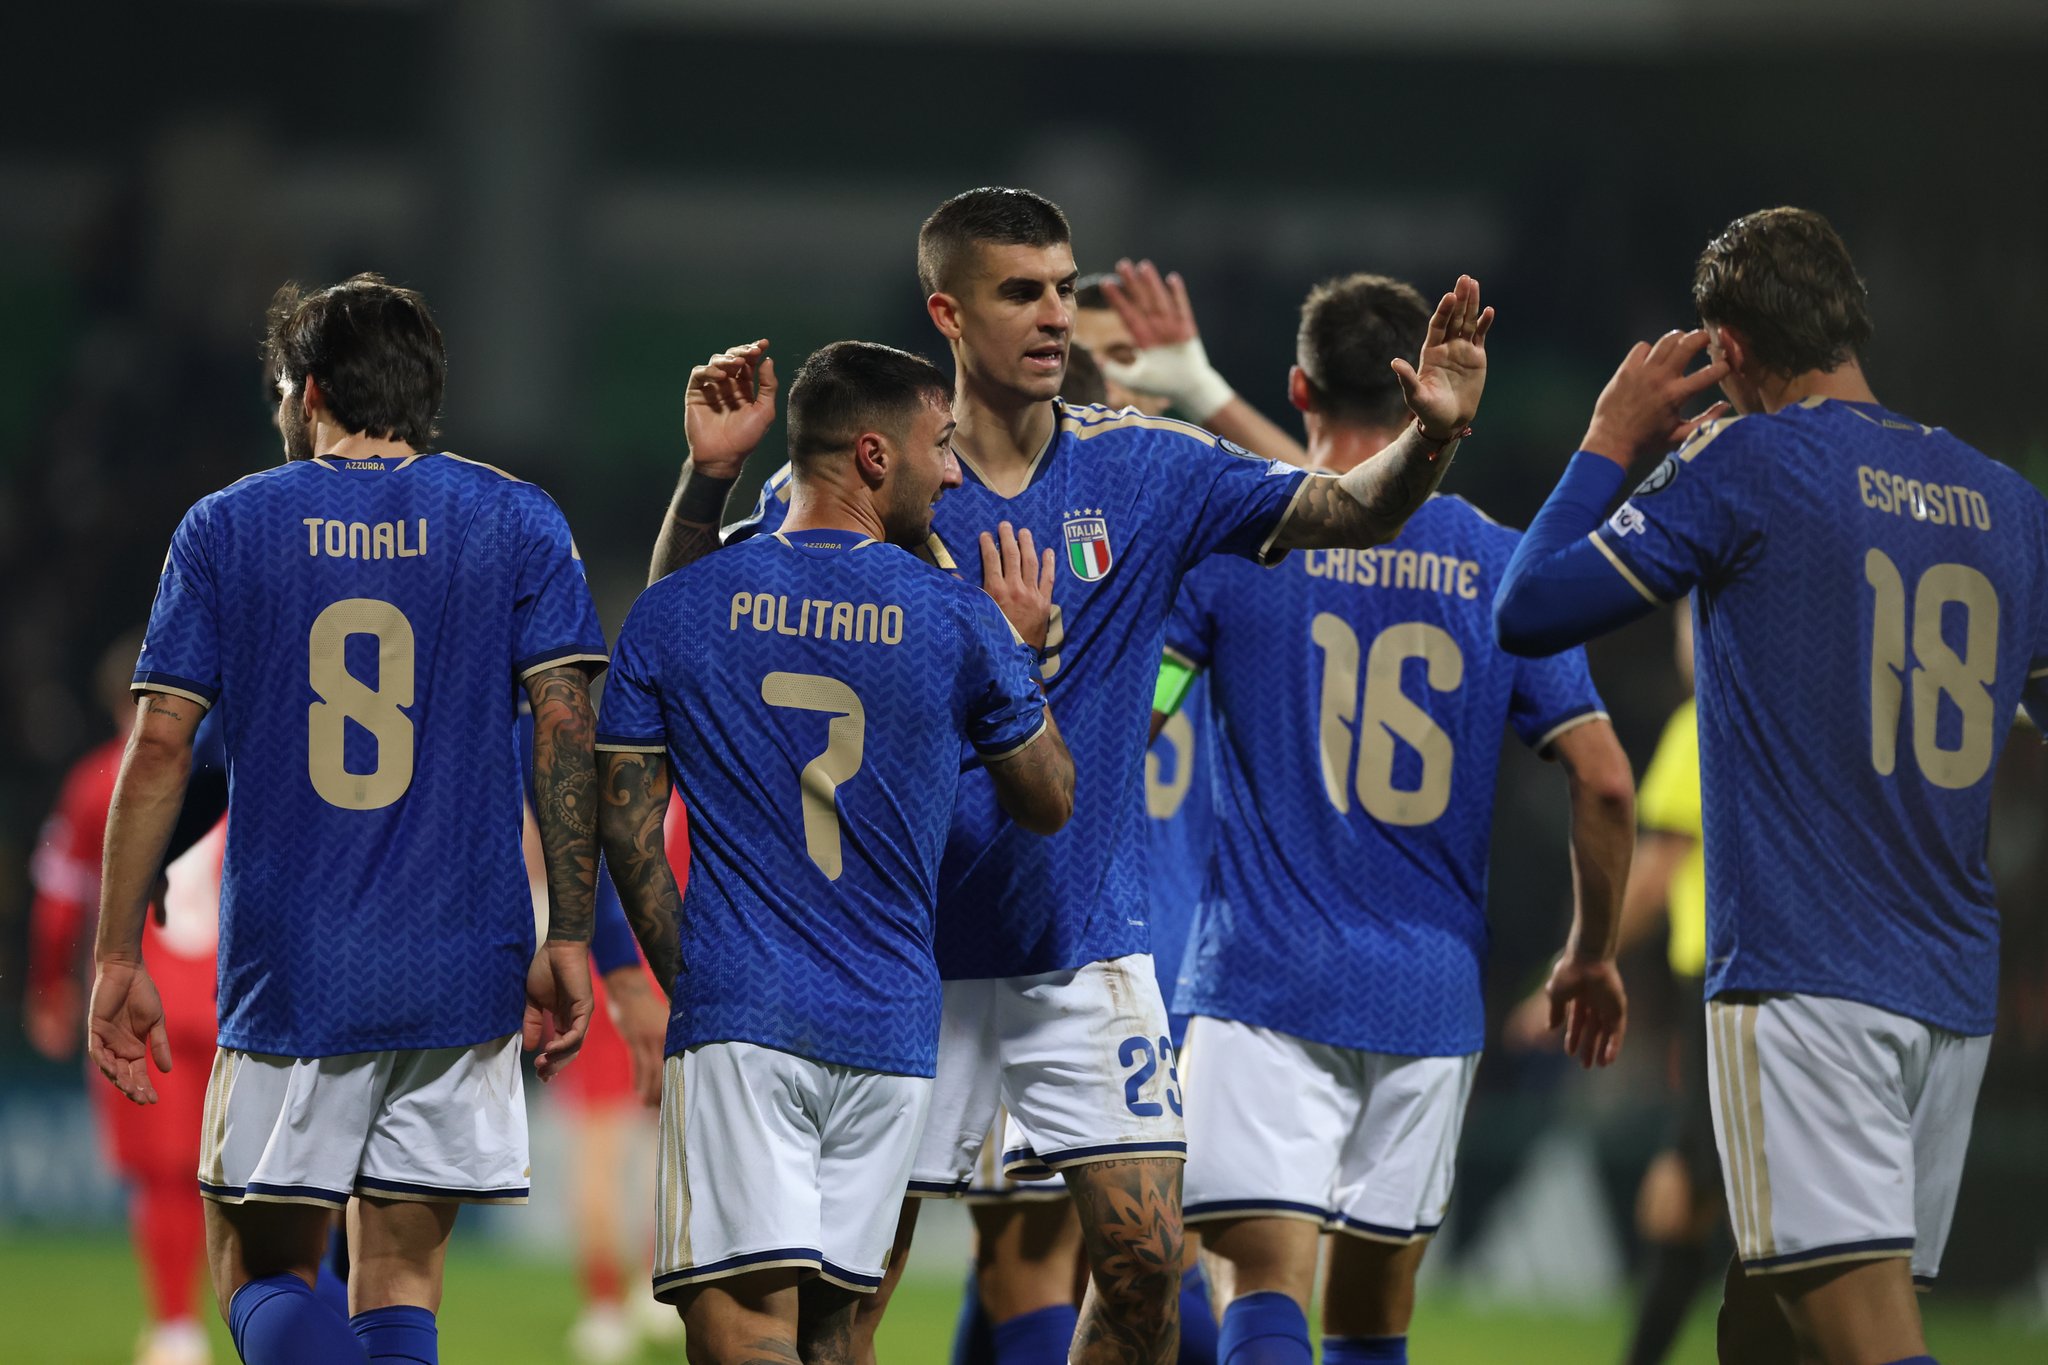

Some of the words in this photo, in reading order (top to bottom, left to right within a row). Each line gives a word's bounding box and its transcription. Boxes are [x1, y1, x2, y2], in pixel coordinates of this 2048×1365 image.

[345, 461, 385, 471] AZZURRA
[1858, 465, 1991, 531] ESPOSITO
[303, 518, 427, 560] TONALI
[803, 542, 841, 550] AZZURRA
[1067, 523, 1103, 538] ITALIA
[1304, 549, 1480, 600] CRISTANTE
[730, 592, 903, 645] POLITANO
[1865, 548, 1998, 789] 18
[309, 598, 415, 810] 8
[1311, 612, 1464, 826] 16
[761, 671, 865, 881] 7
[1118, 1036, 1183, 1118] 23
